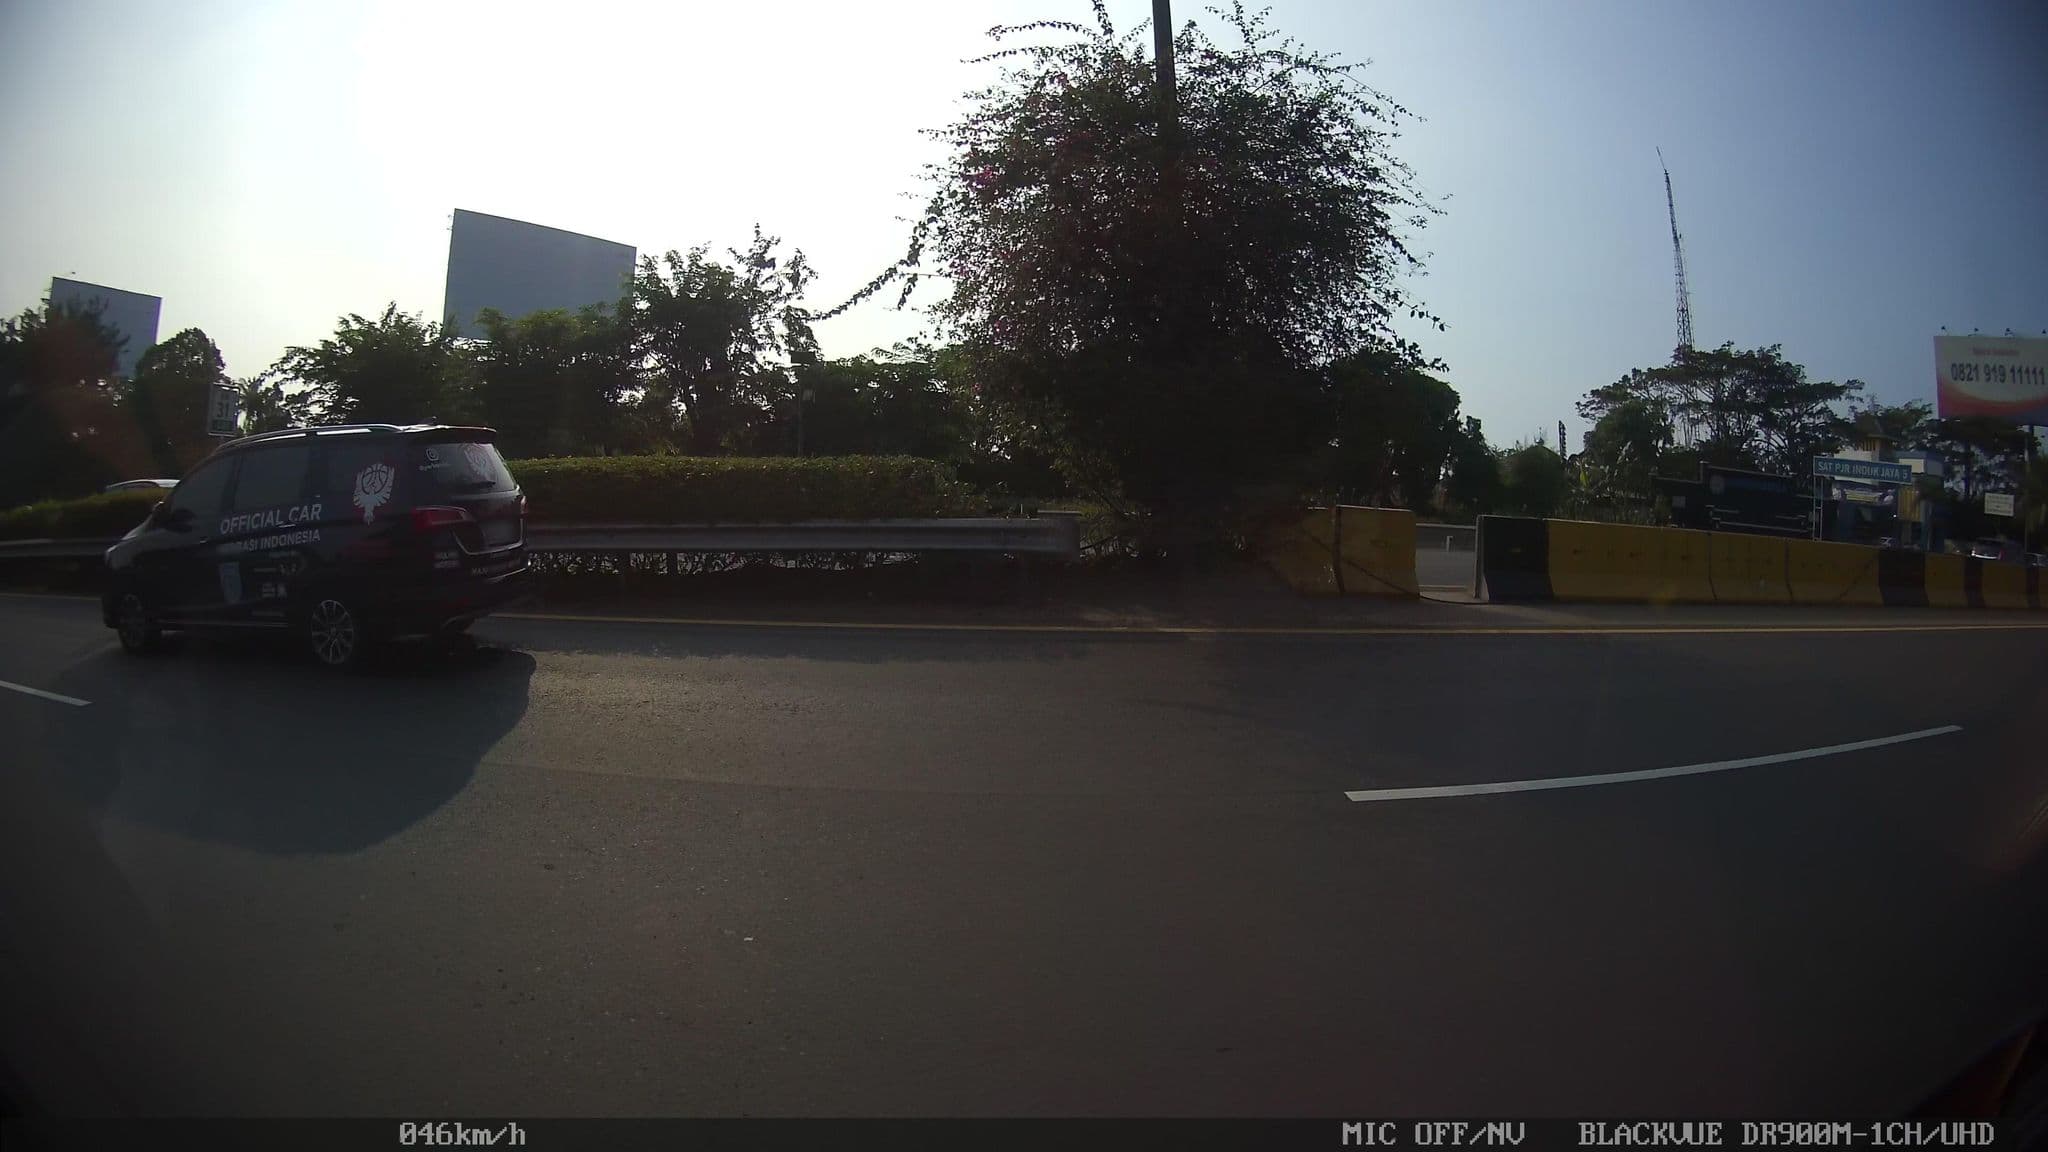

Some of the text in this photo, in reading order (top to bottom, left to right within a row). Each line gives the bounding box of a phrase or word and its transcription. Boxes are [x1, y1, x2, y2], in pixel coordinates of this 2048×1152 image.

[1951, 362, 2045, 384] 0821 919 11111
[217, 402, 229, 418] 31
[1818, 461, 1833, 472] SAT
[1881, 466, 1900, 479] JAYA
[220, 503, 322, 535] OFFICIAL CAR
[260, 529, 321, 549] INDONESIA
